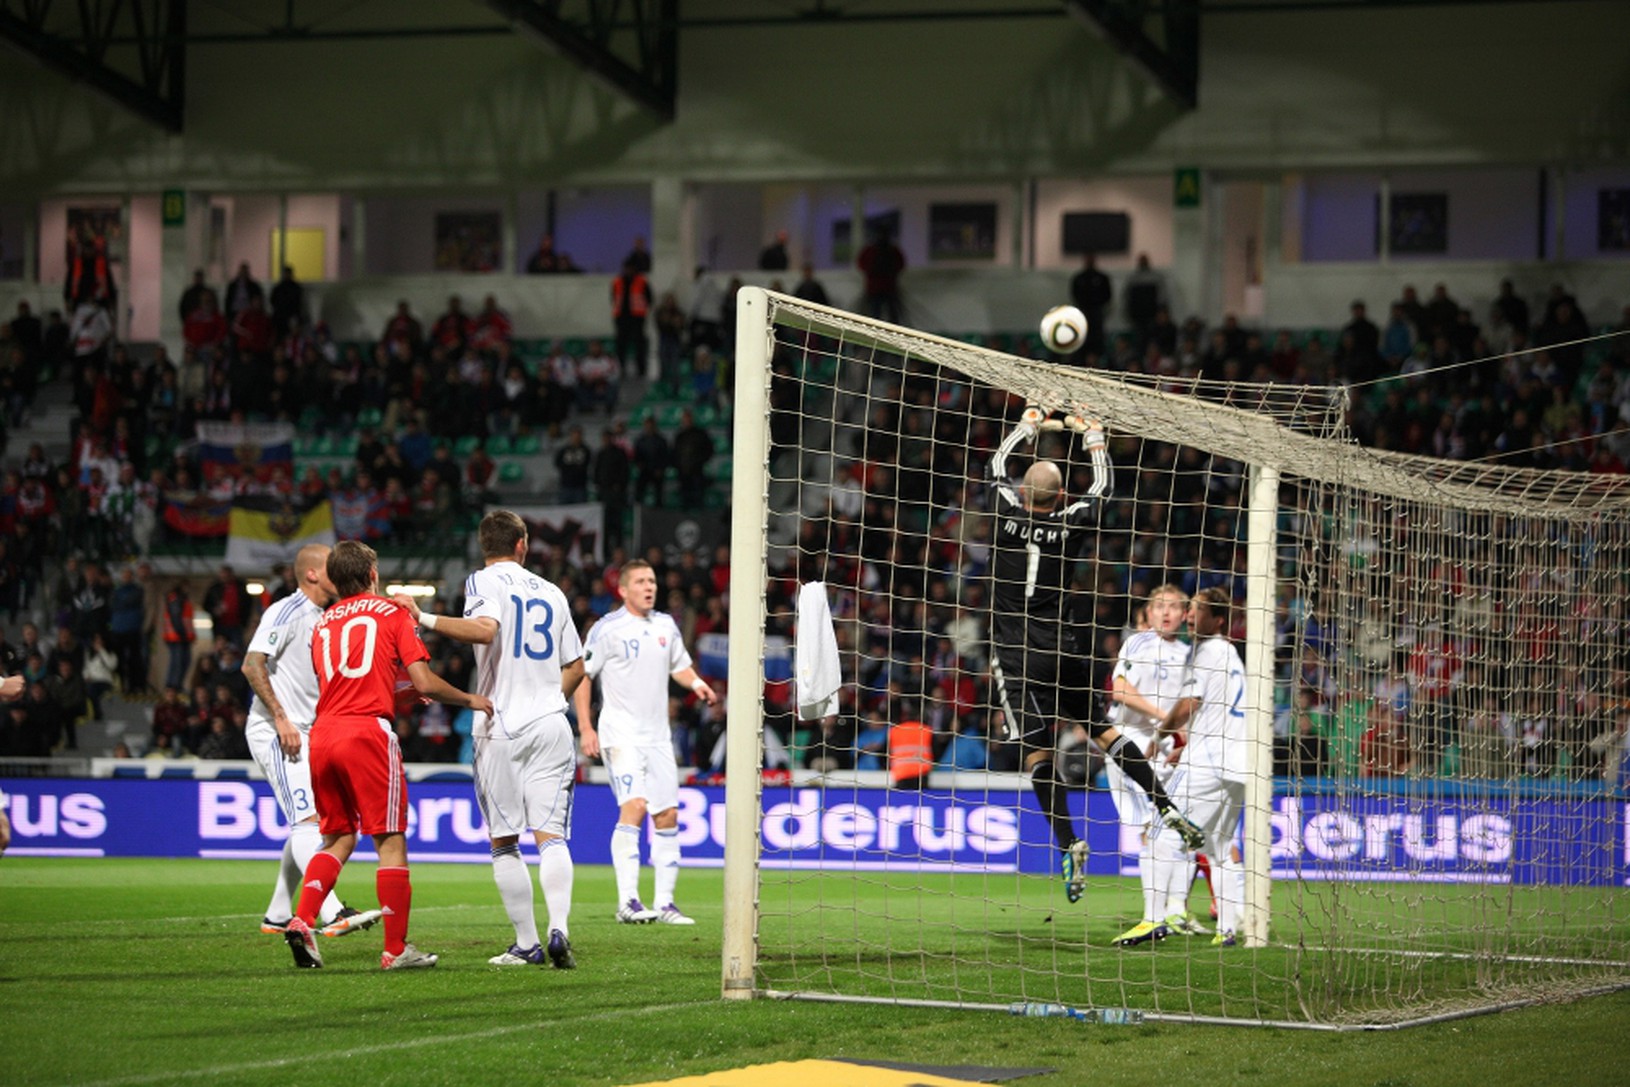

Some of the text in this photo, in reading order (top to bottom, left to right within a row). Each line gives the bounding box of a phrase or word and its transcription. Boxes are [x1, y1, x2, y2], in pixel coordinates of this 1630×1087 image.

[1025, 543, 1040, 597] 1
[320, 615, 377, 682] 10
[511, 594, 553, 660] 13
[623, 638, 640, 660] 19
[1228, 669, 1245, 719] 2
[293, 788, 309, 811] 3
[615, 773, 633, 797] 19
[2, 792, 107, 839] us
